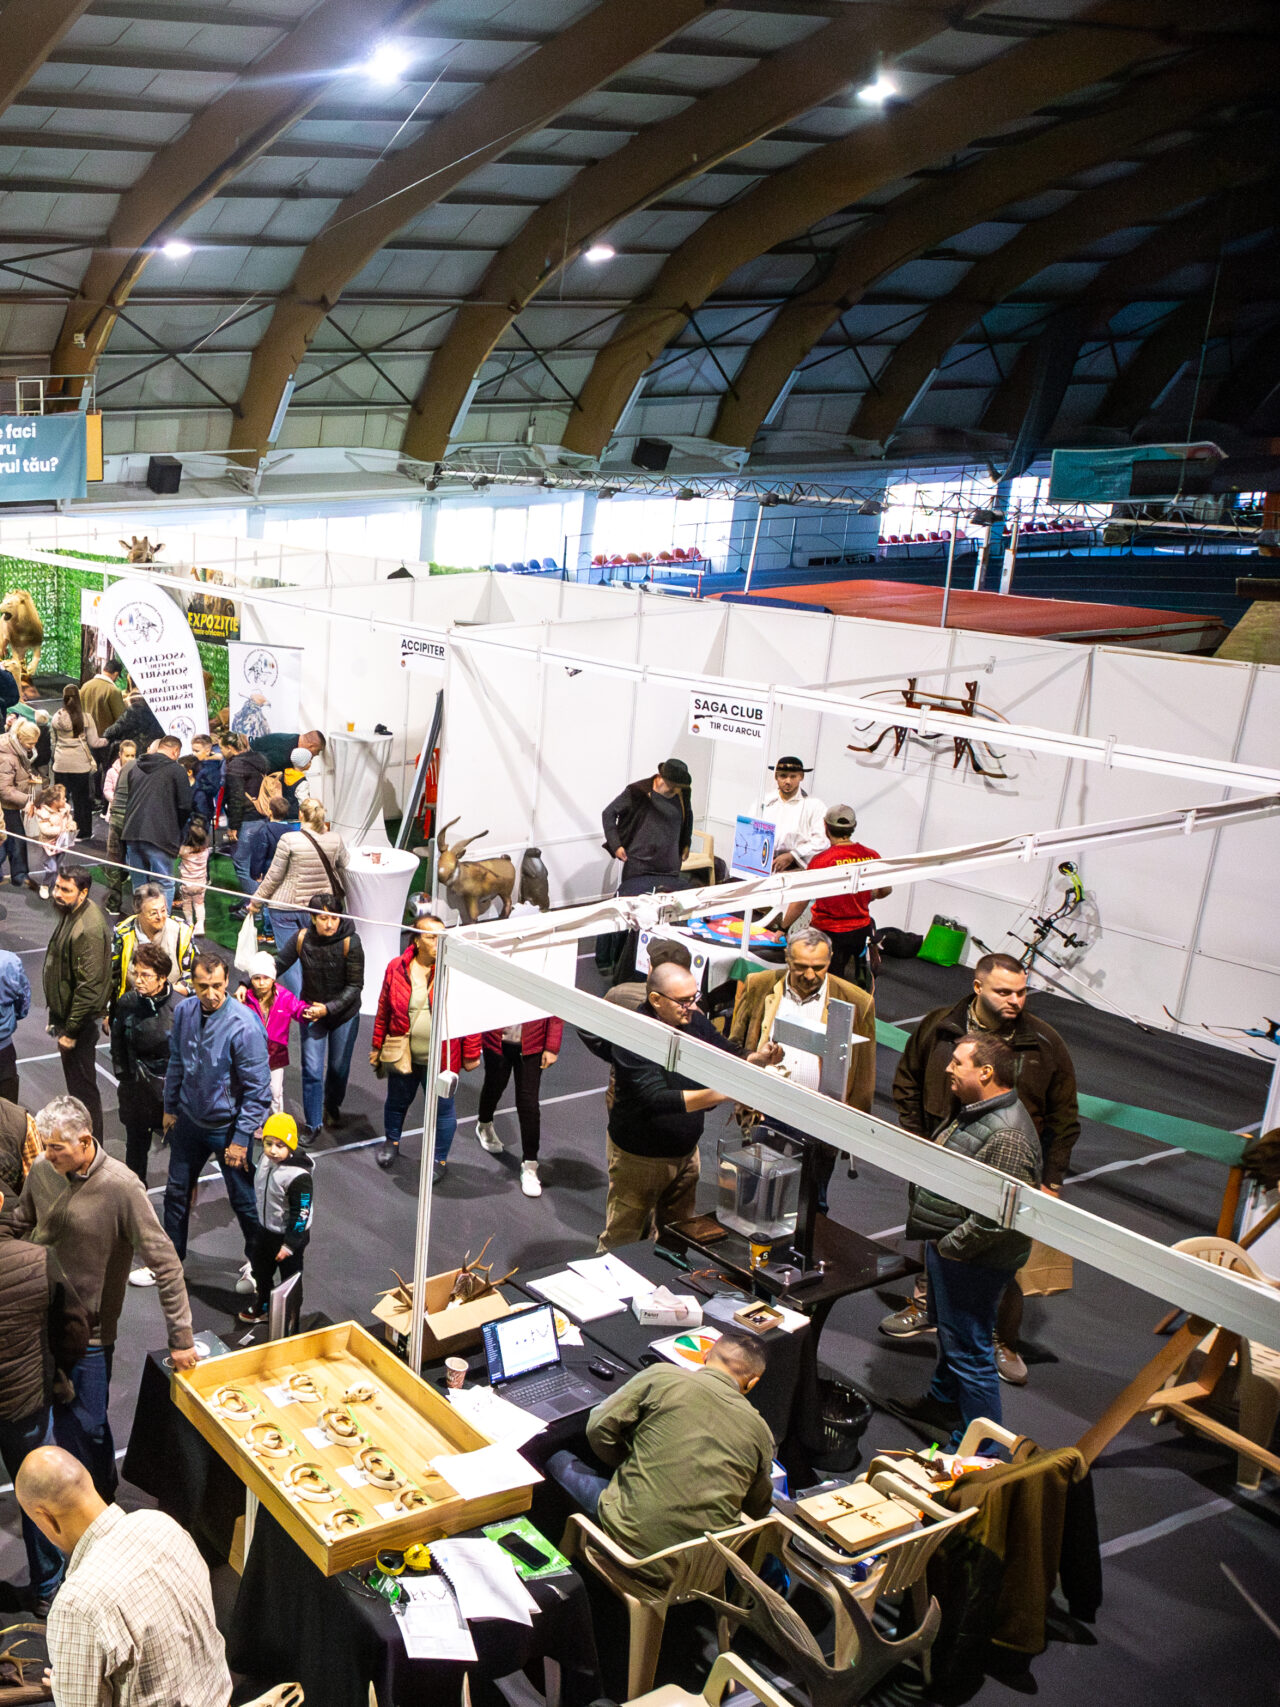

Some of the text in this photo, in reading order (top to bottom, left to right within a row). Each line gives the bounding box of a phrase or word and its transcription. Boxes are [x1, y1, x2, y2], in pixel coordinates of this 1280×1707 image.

[5, 423, 37, 439] faci
[22, 456, 59, 473] tău?
[401, 639, 445, 656] ACCIPITER
[694, 698, 763, 720] SAGA CLUB
[710, 721, 762, 738] TIR CU ARCUL
